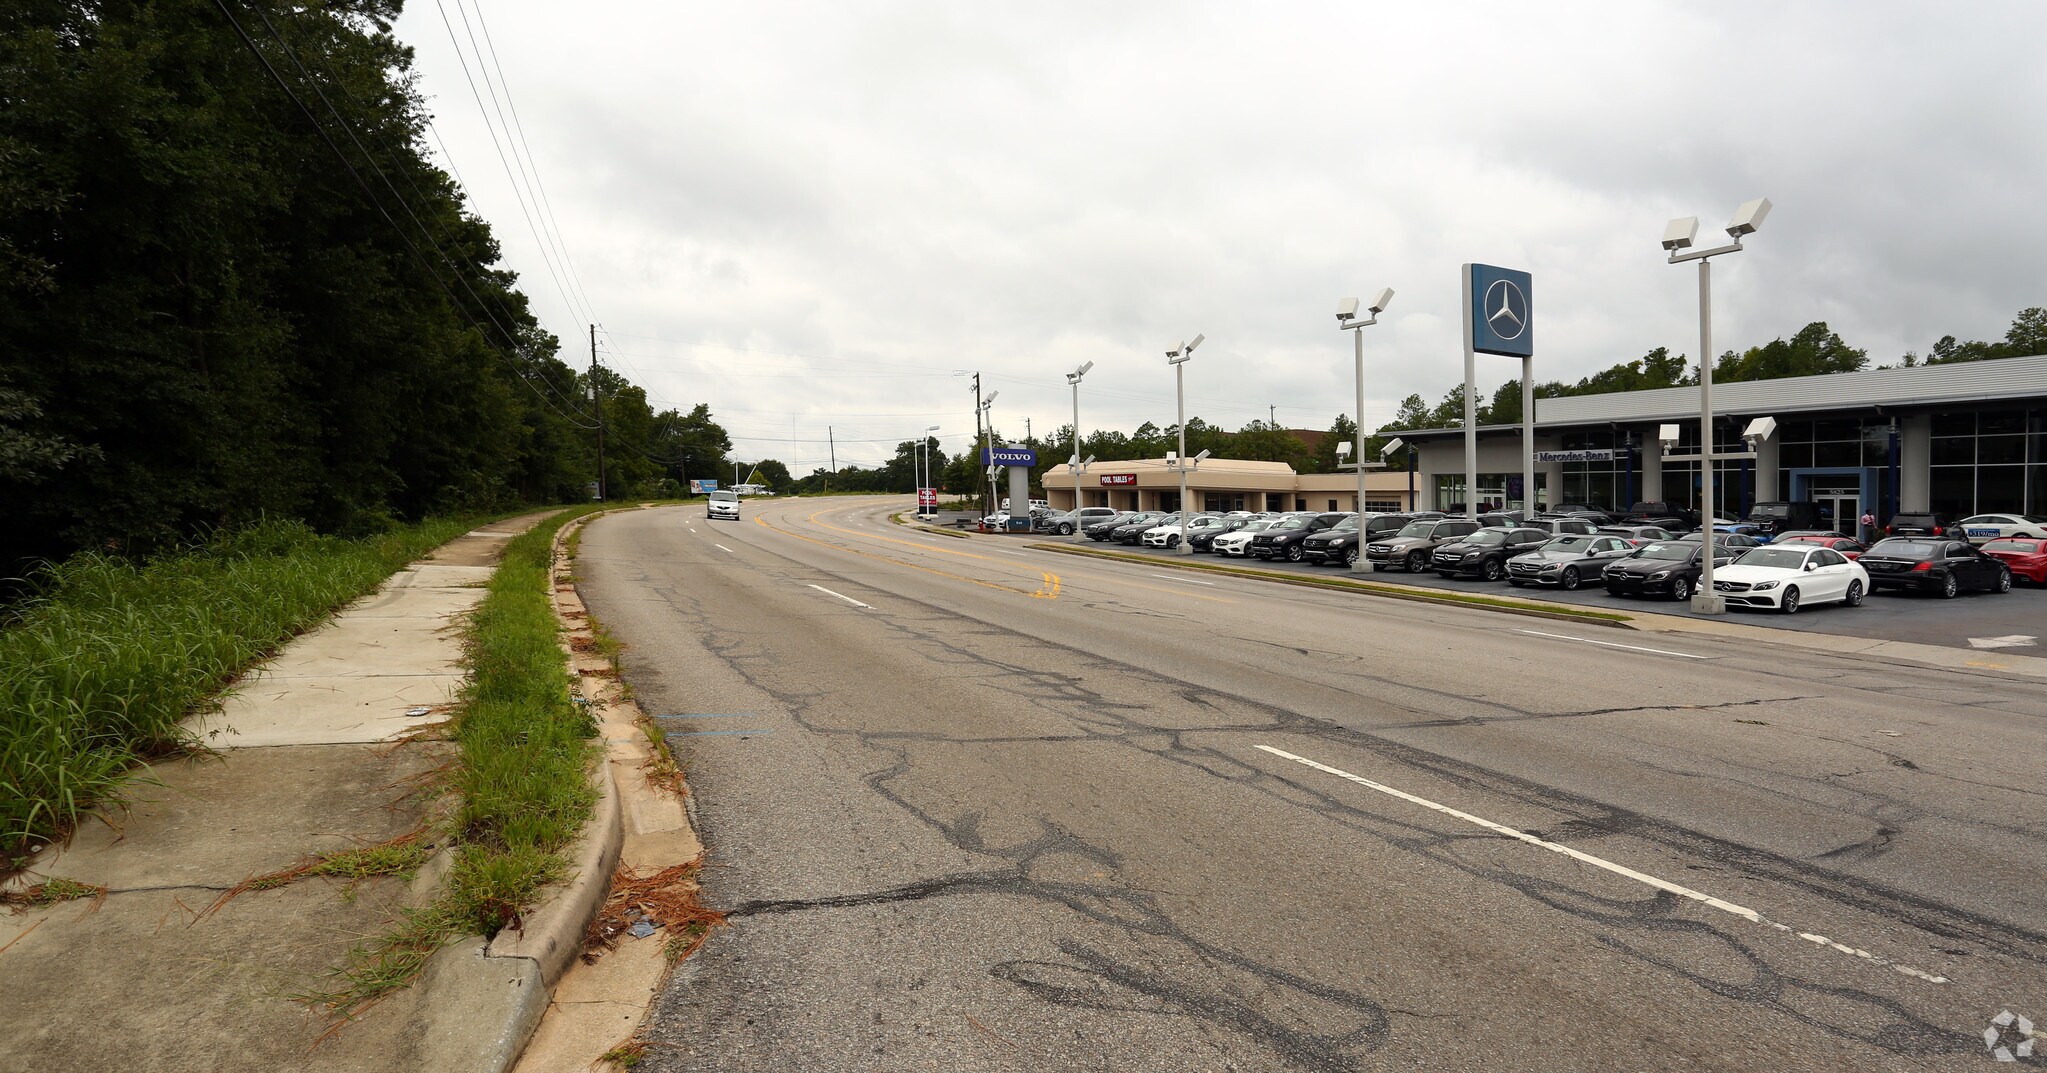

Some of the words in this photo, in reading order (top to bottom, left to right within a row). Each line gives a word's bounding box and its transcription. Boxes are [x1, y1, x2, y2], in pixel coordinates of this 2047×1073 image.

[989, 453, 1031, 461] VOLVO
[1539, 451, 1610, 461] Mercedes-Benz
[1101, 476, 1112, 484] POOL
[1112, 475, 1128, 483] TABLES
